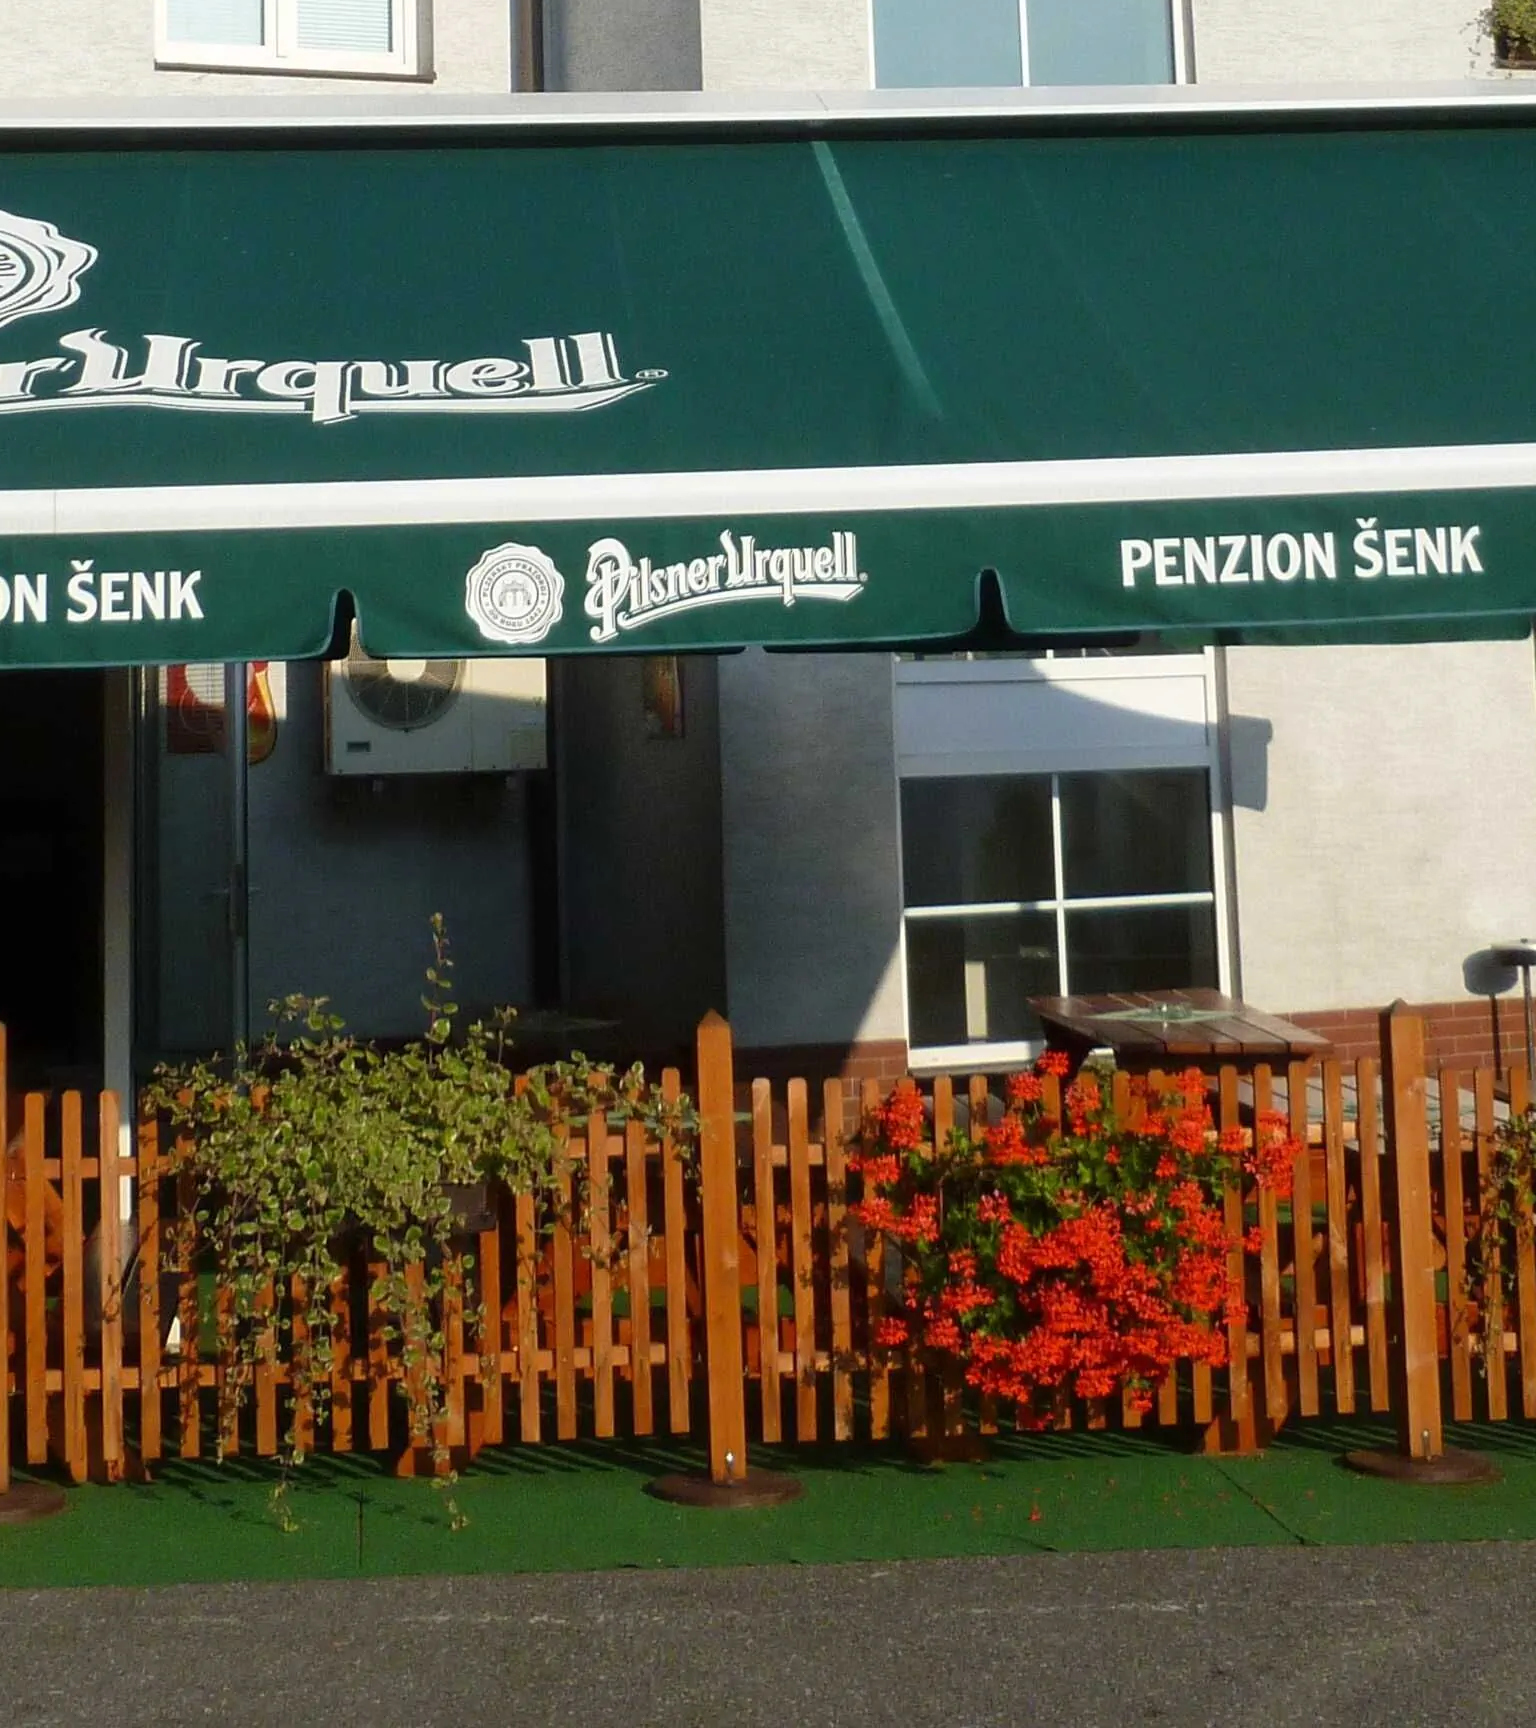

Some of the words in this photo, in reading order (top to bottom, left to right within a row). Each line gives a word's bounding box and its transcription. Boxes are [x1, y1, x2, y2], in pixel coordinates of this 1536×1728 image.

[58, 312, 629, 424] Urquell
[66, 560, 205, 622] ŠENK
[584, 538, 728, 643] Pilsner
[720, 529, 858, 607] Urquell
[1121, 532, 1337, 588] PENZION
[1354, 518, 1484, 579] ŠENK
